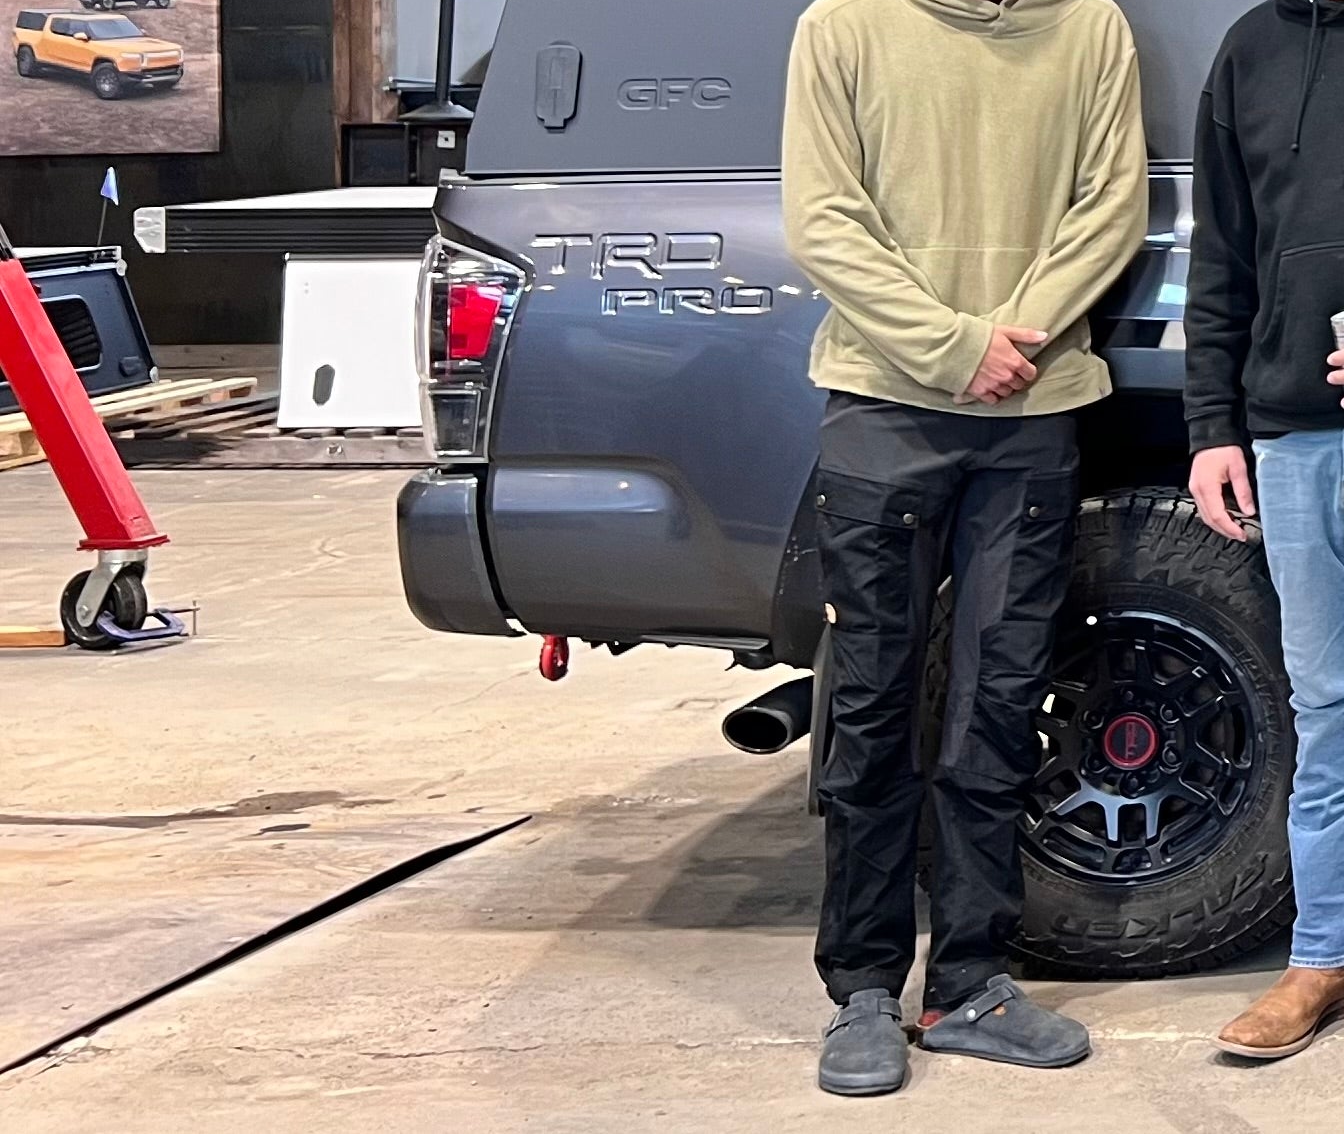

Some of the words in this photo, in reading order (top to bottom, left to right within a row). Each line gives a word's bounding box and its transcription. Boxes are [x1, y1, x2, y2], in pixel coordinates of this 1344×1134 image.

[617, 77, 732, 110] GFC
[530, 232, 724, 280] TRD
[601, 286, 774, 316] PRO
